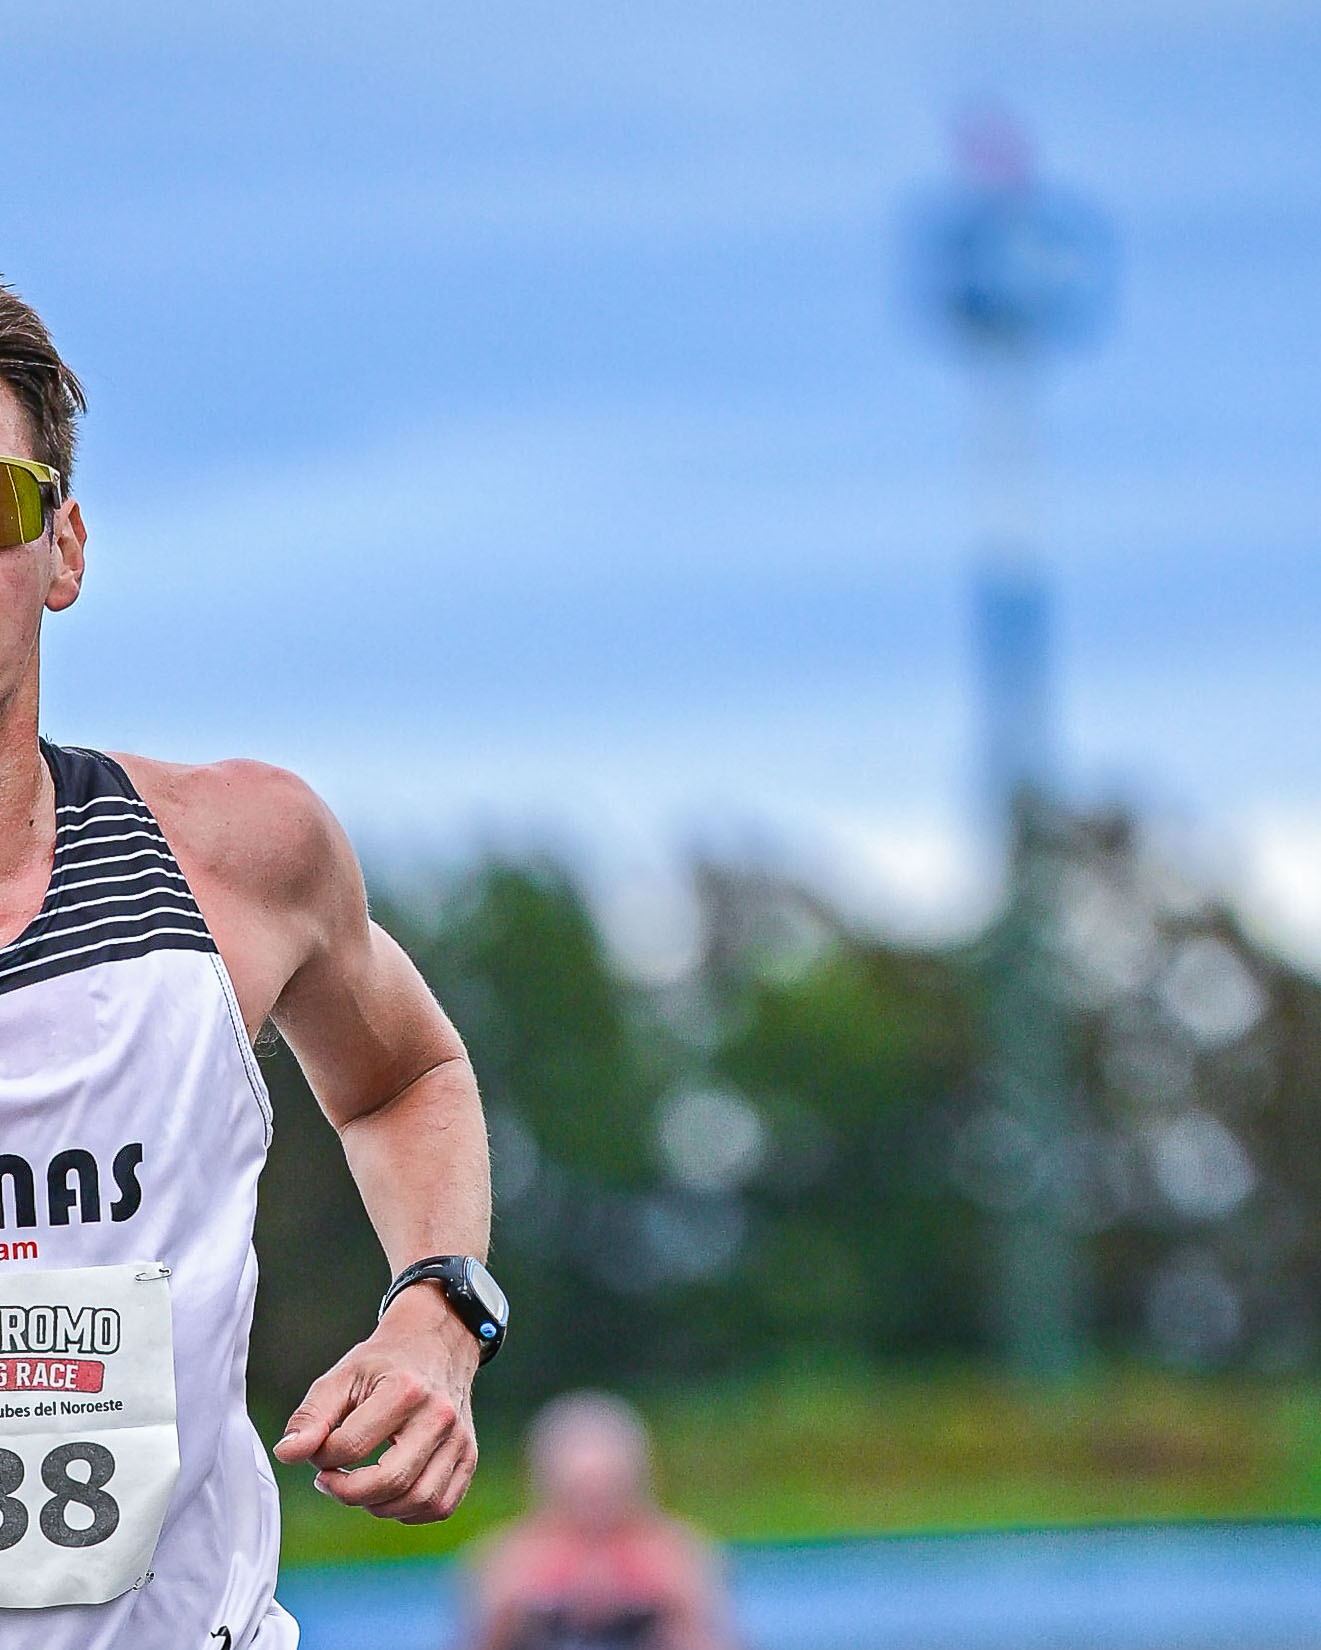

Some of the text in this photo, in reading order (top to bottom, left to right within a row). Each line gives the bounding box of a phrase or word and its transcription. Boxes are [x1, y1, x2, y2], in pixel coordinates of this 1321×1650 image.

[16, 1362, 79, 1389] RACE
[34, 1402, 56, 1416] del
[61, 1400, 123, 1415] Noroeste
